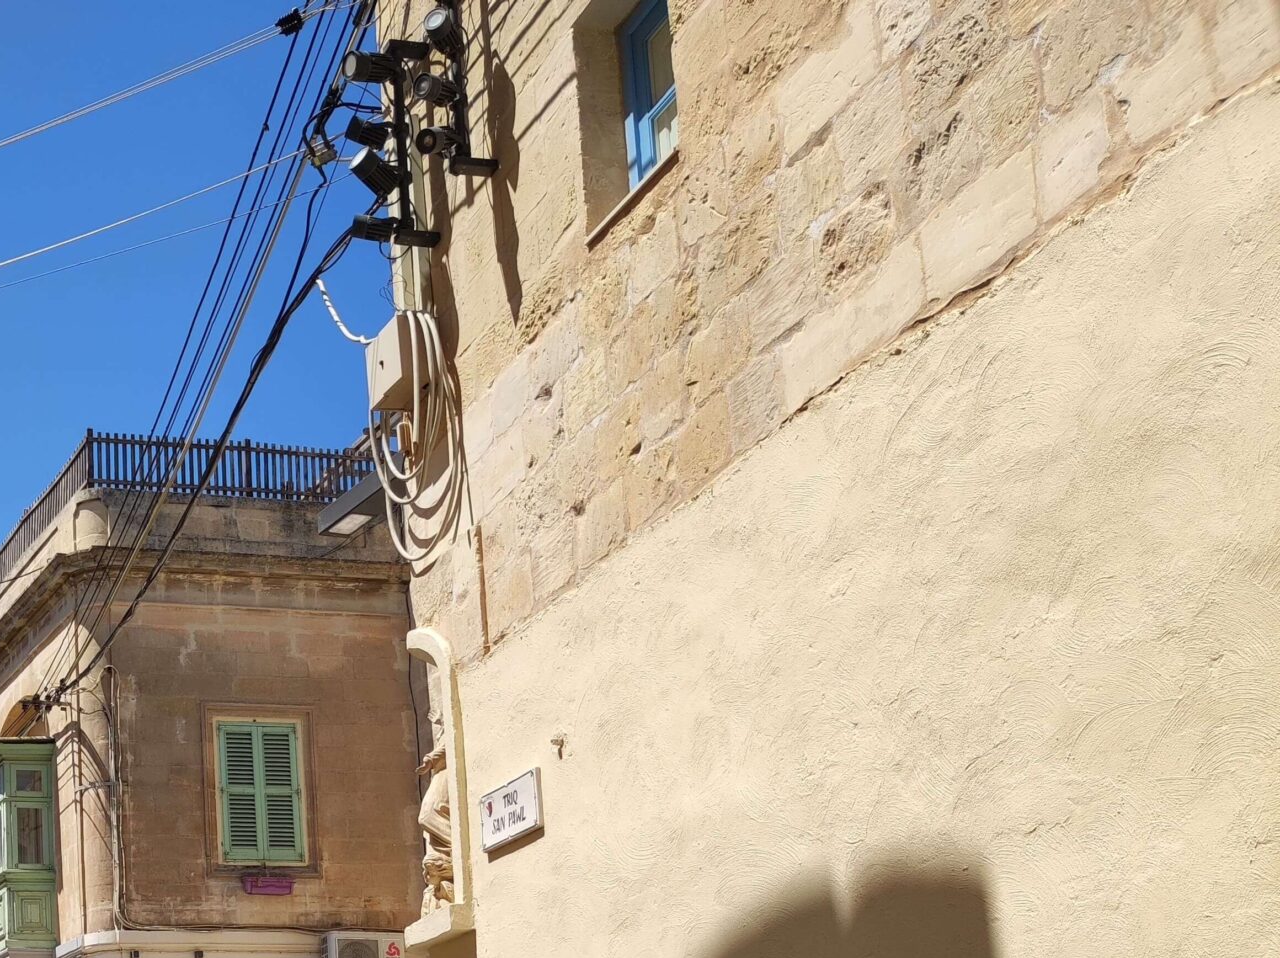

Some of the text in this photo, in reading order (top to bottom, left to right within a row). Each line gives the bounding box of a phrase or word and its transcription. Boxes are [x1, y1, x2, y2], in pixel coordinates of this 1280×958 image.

[502, 789, 518, 809] TRIQ
[492, 805, 526, 834] SAN PAWL
